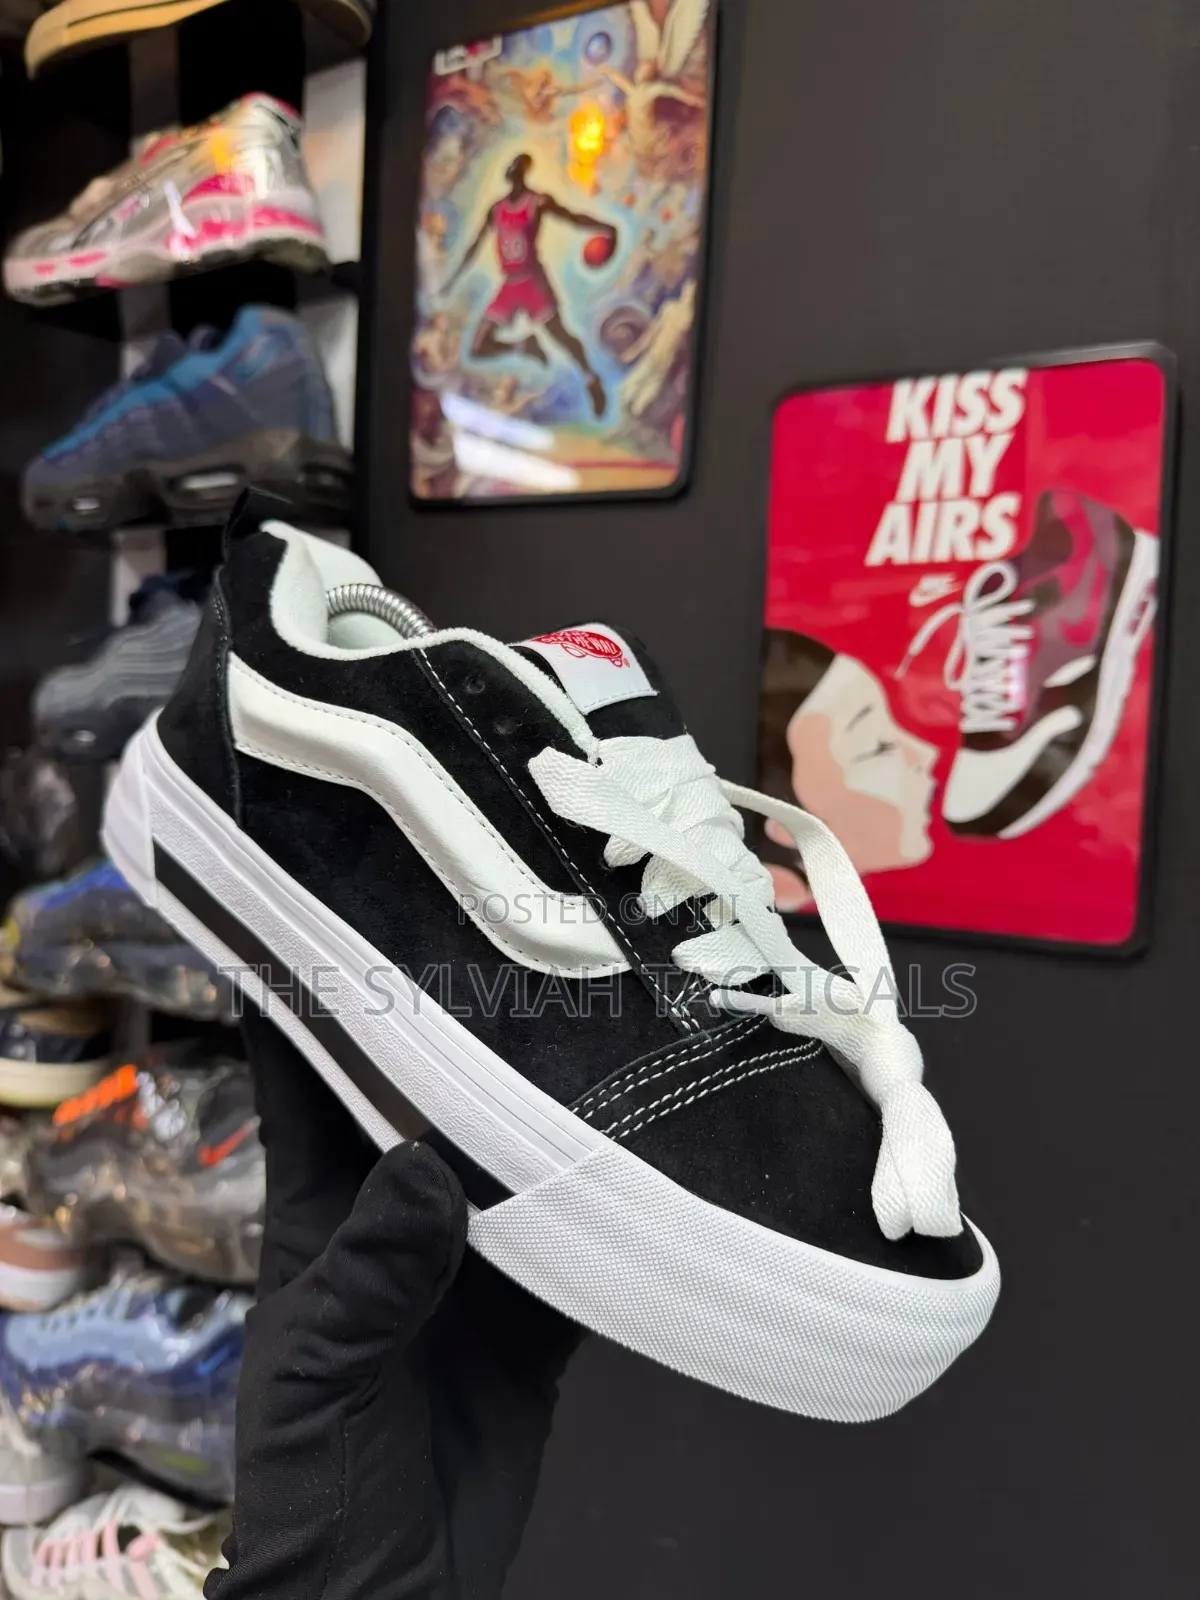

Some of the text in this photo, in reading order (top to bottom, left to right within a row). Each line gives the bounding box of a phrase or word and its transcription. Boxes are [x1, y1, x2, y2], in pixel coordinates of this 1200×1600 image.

[886, 368, 1028, 443] KISS
[896, 432, 1014, 503] MY
[864, 491, 1022, 567] AIRS
